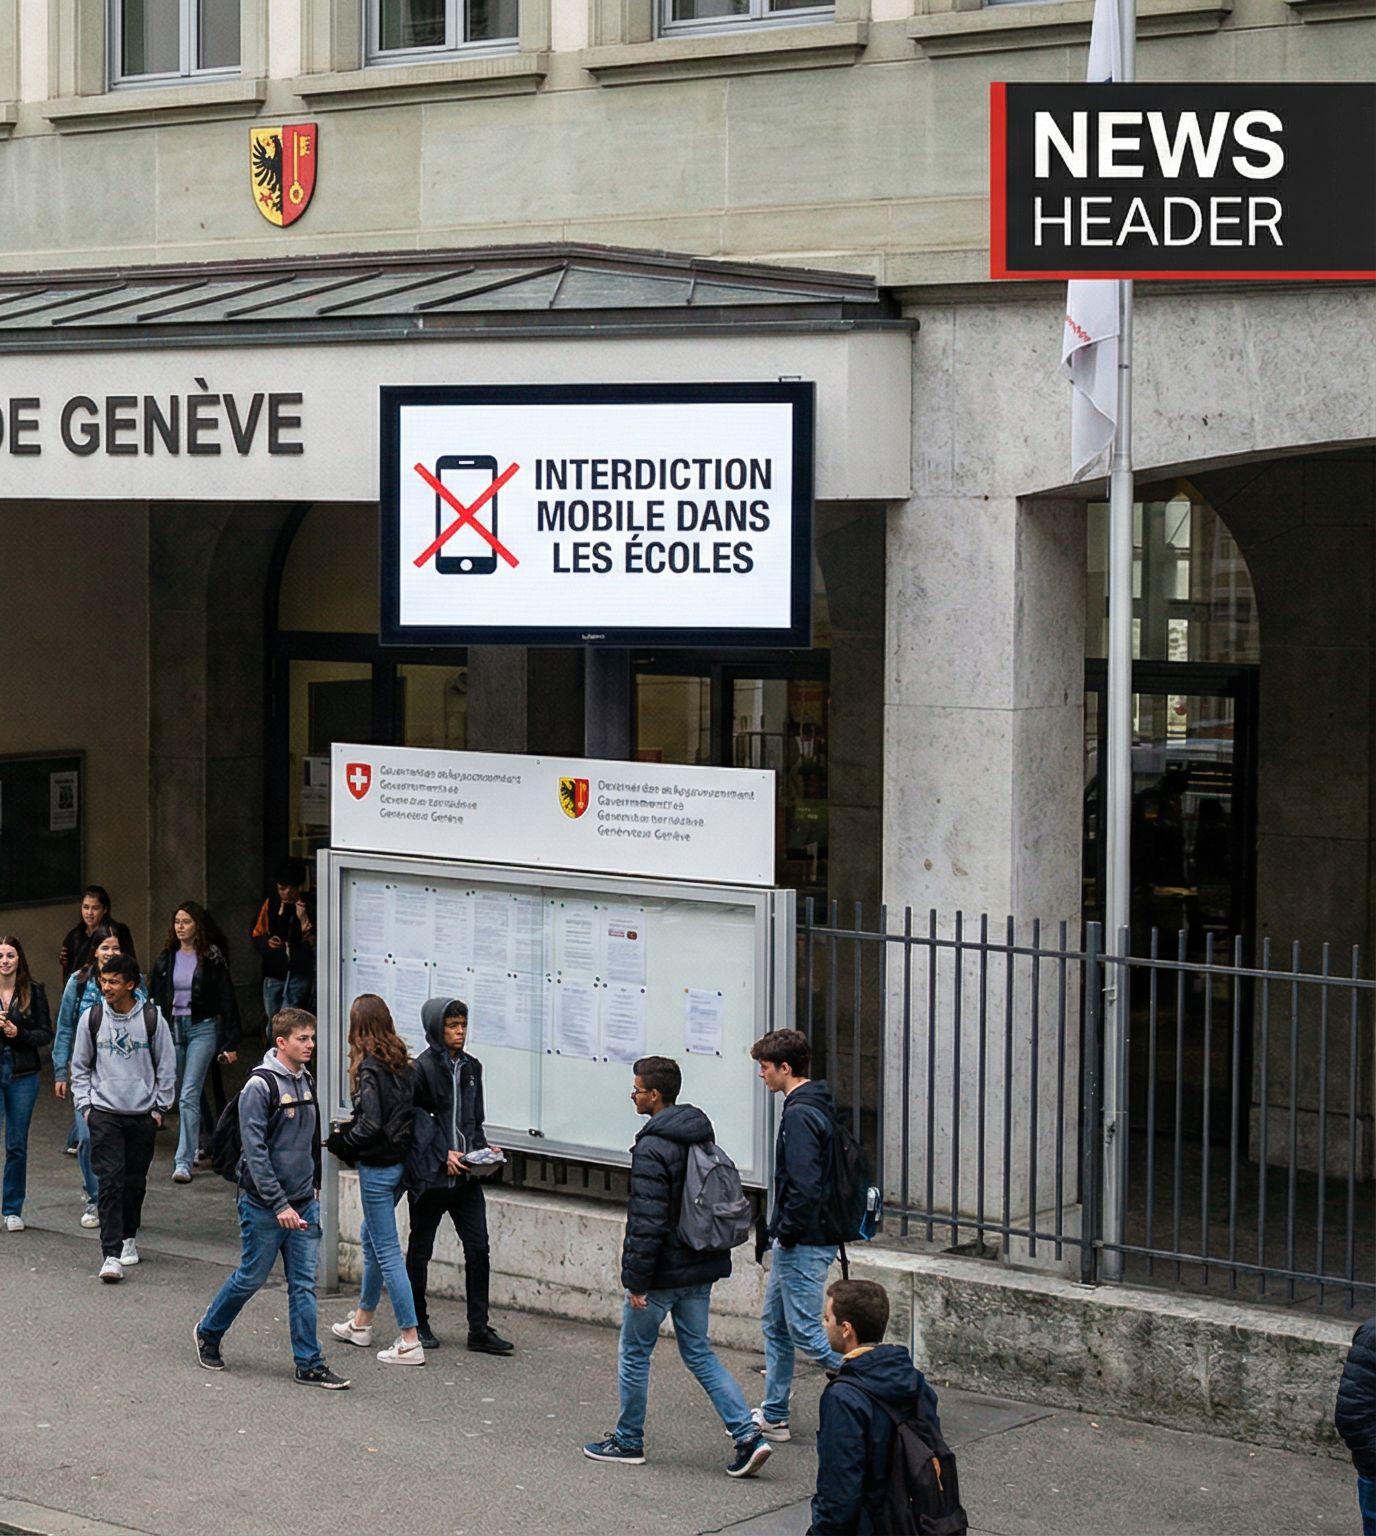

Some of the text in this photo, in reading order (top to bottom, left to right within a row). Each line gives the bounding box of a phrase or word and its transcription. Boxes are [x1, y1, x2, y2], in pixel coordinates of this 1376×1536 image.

[60, 377, 305, 458] GENÈVE
[535, 457, 772, 491] INTERDICTION
[537, 499, 771, 532] MOBILE DANS
[553, 533, 754, 574] LES ÉCOLES
